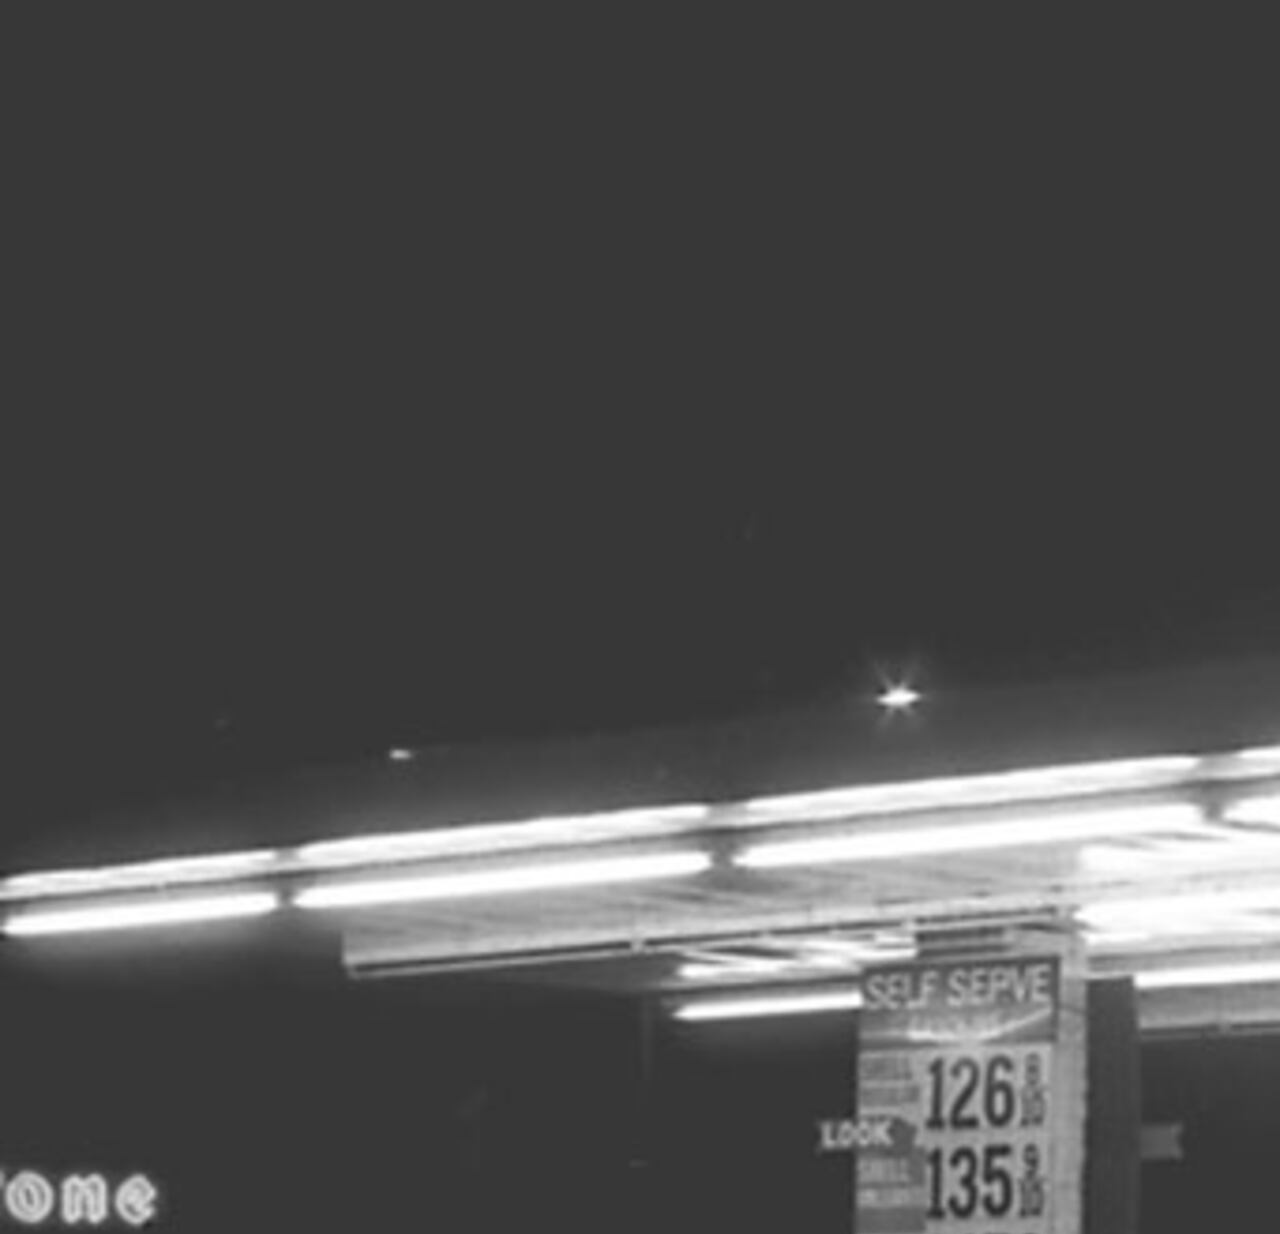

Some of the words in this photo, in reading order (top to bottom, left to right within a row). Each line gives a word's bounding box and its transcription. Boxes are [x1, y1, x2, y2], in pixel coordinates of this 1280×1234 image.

[865, 970, 940, 1010] SELF
[946, 964, 1052, 1007] SERVE
[925, 1054, 1016, 1131] 126
[819, 1120, 896, 1149] LOOK
[0, 1169, 156, 1227] one
[925, 1144, 1013, 1219] 135
